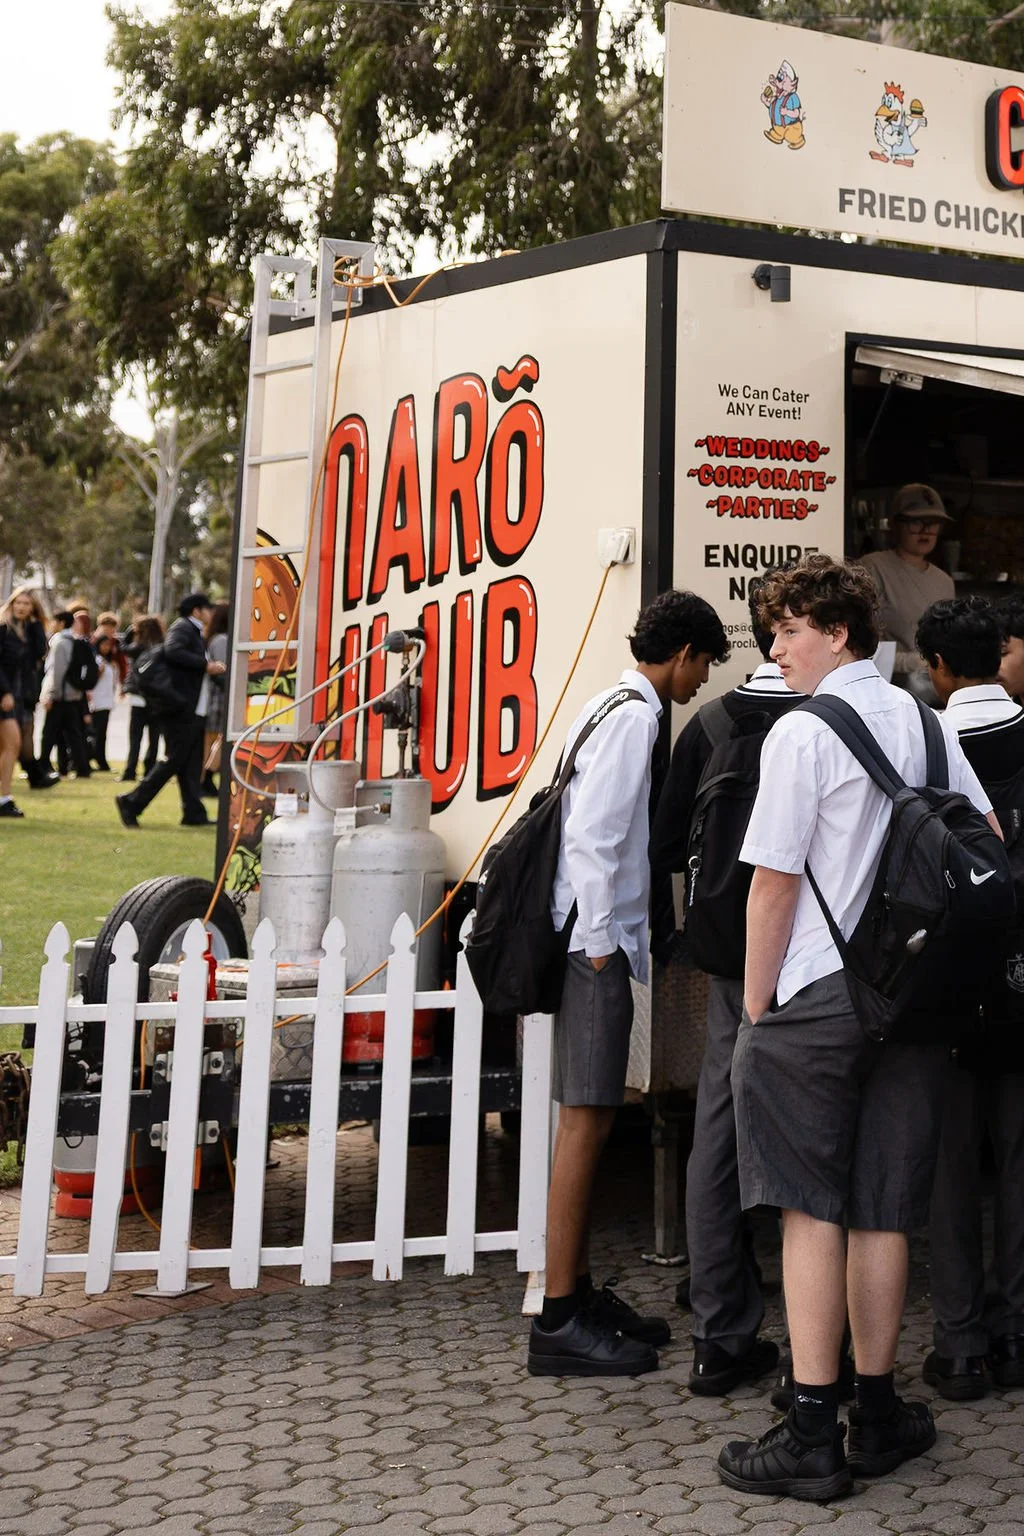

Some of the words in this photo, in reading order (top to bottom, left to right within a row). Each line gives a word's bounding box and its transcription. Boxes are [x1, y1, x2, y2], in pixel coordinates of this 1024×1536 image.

[838, 187, 926, 224] FRIED
[718, 383, 739, 399] We
[742, 384, 769, 401] Can
[772, 387, 809, 403] Cater
[726, 402, 754, 416] ANY
[758, 404, 801, 420] Event!
[704, 544, 819, 571] ENQUIR
